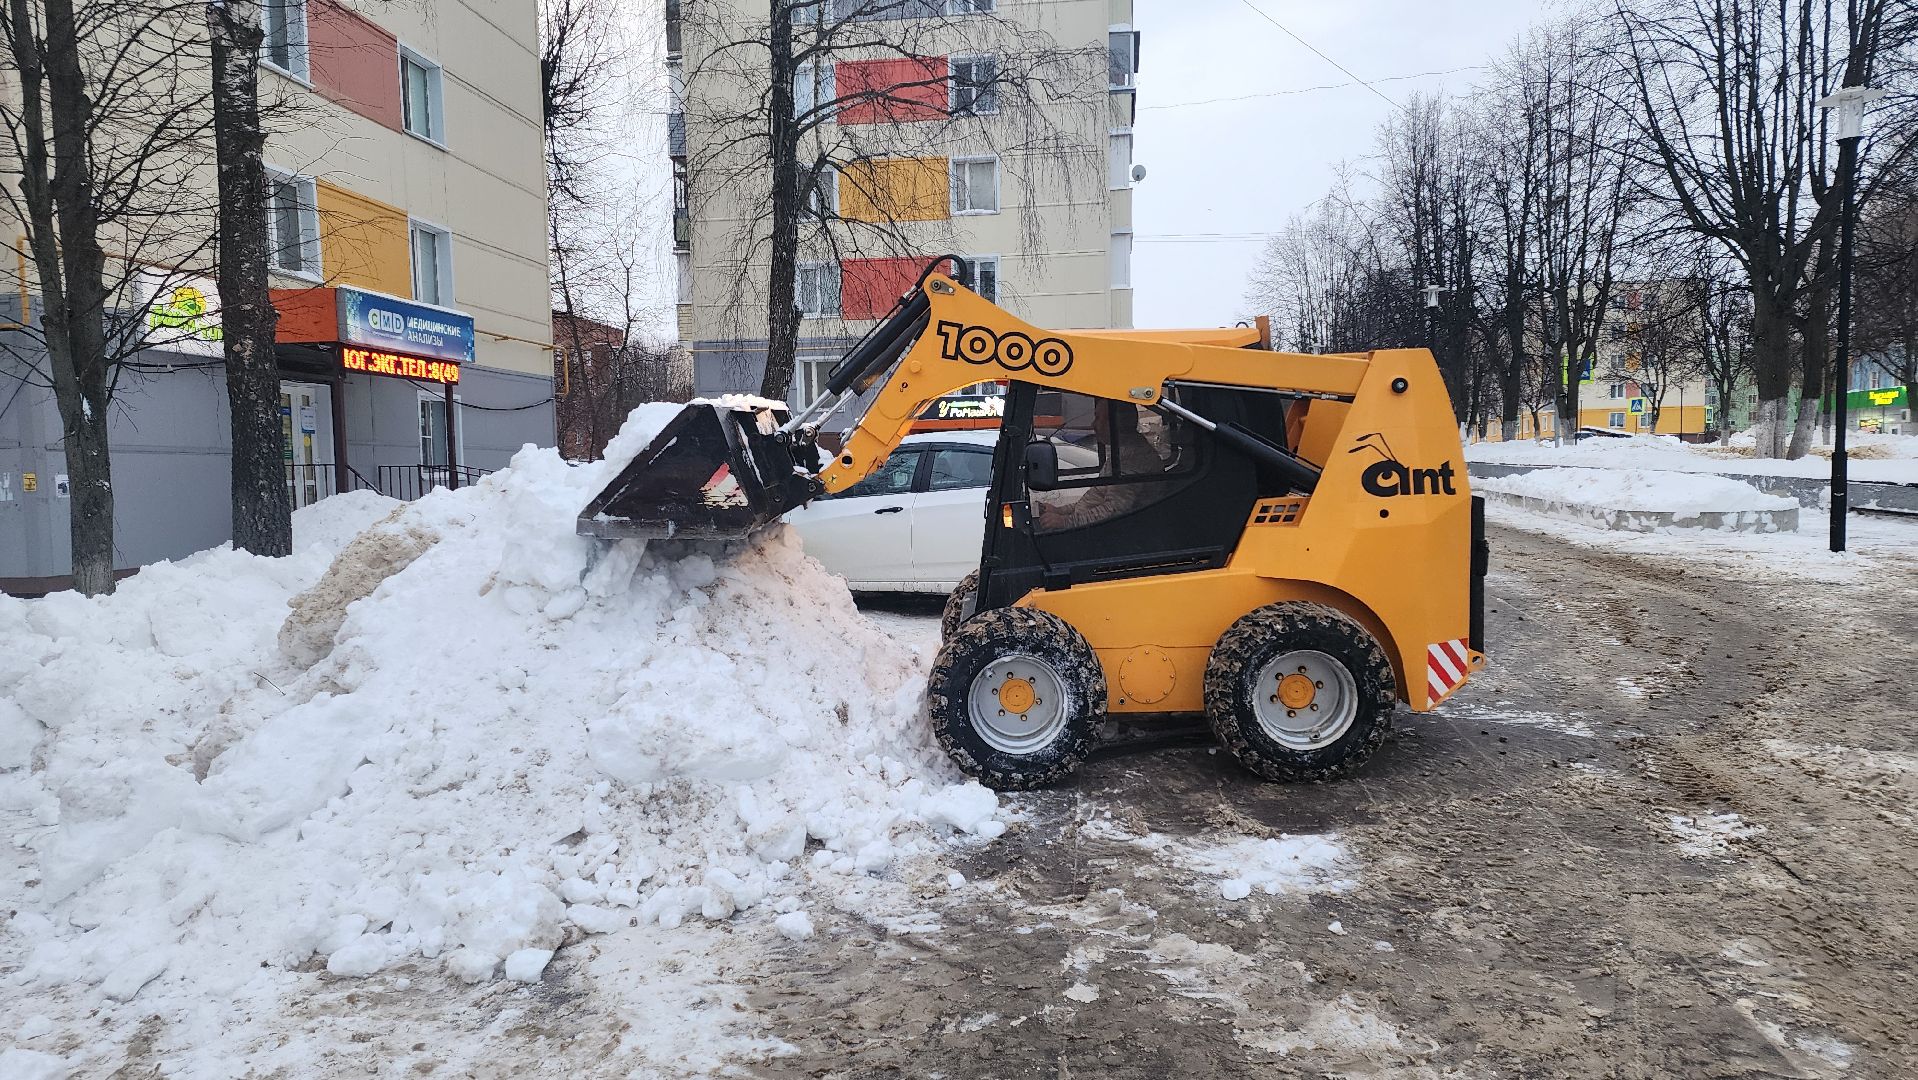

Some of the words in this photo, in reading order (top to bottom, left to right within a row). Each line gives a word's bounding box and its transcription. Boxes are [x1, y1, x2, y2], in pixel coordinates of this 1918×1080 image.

[370, 310, 403, 331] CMD
[407, 316, 461, 337] МЕДИЦИНСКИЕ
[408, 331, 444, 347] АНАЛИЗЫ
[937, 320, 1074, 377] 1000
[1361, 459, 1456, 497] ant
